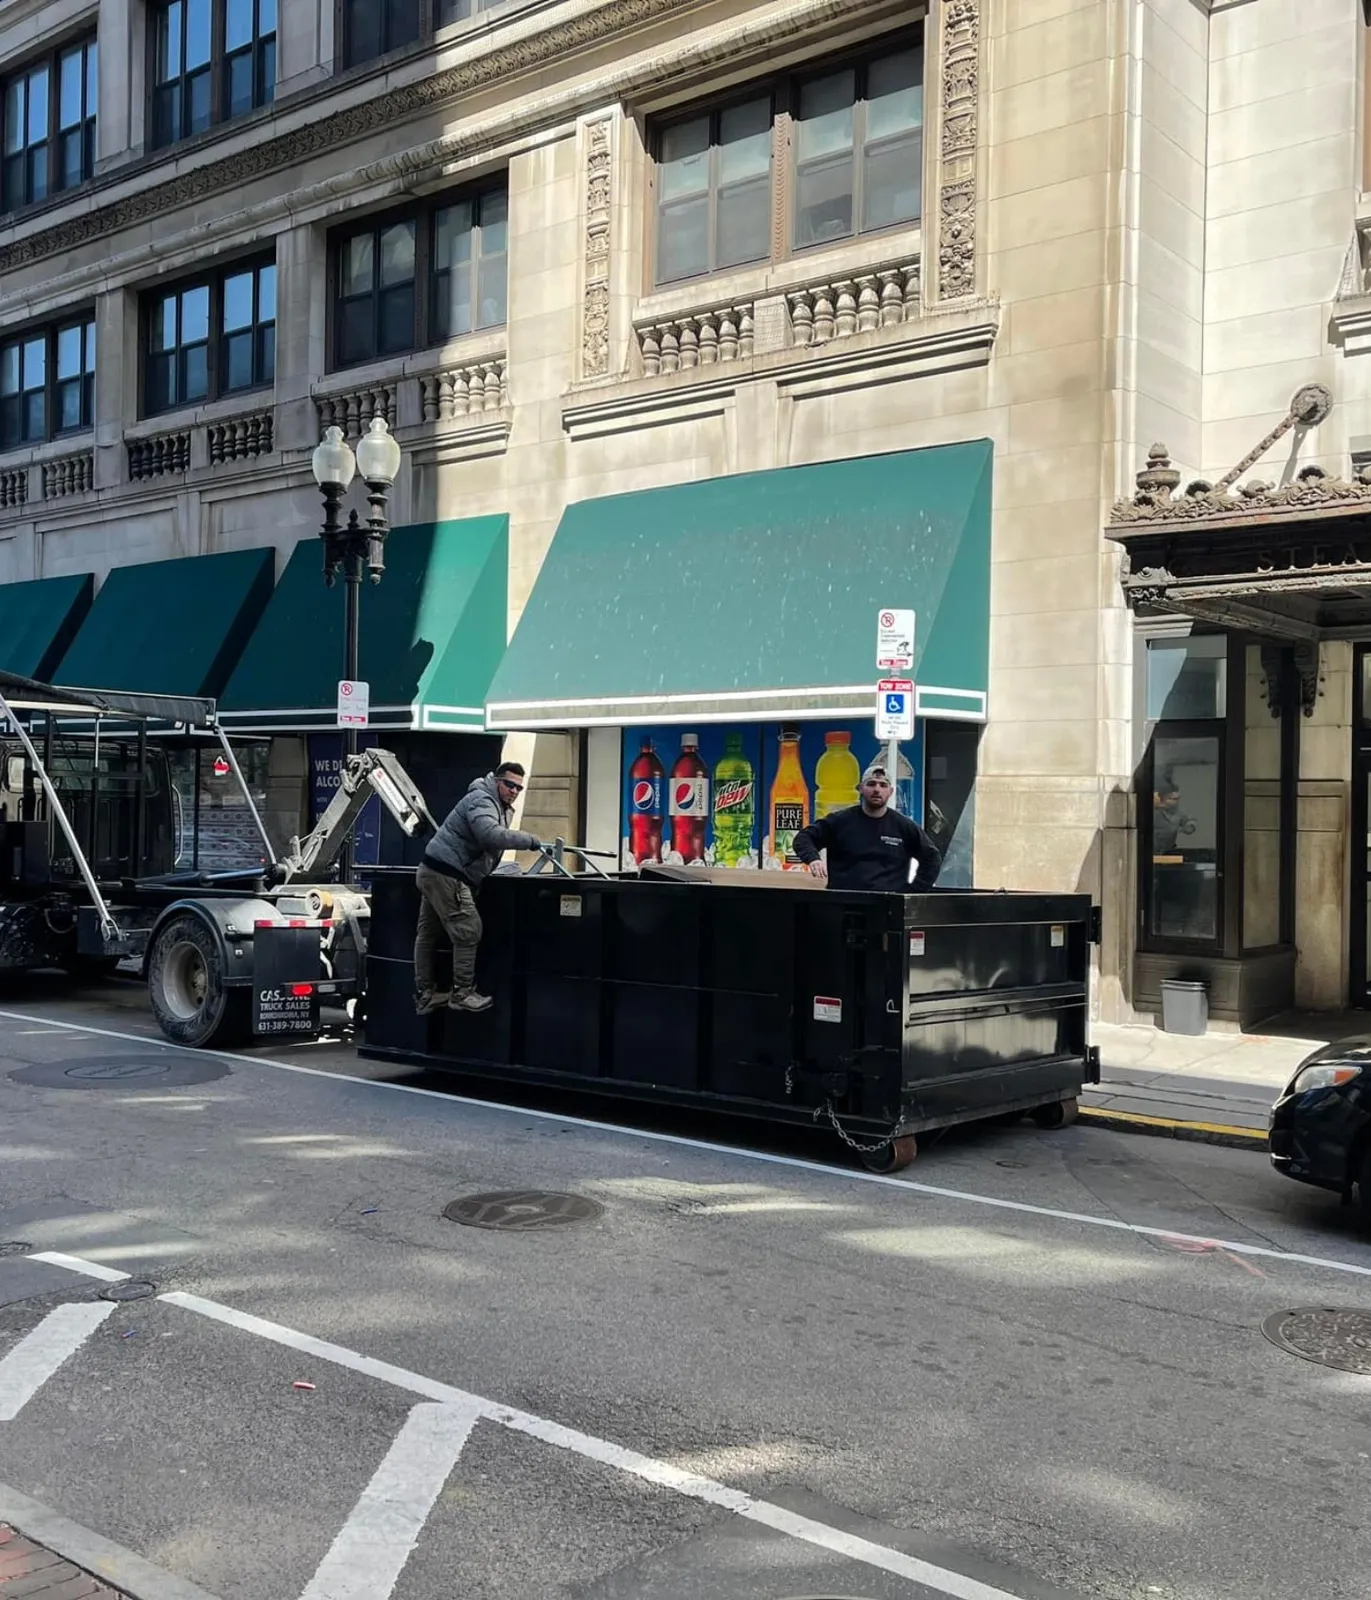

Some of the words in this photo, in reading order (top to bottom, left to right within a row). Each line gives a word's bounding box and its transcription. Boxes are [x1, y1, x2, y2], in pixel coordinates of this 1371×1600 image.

[315, 759, 330, 771] WE
[316, 776, 341, 787] ALCO
[776, 809, 802, 819] PURE
[776, 820, 800, 829] LEAF
[260, 1002, 283, 1011] TRUCK
[285, 1002, 311, 1010] SALES
[259, 1021, 312, 1031] 631-389-7800
